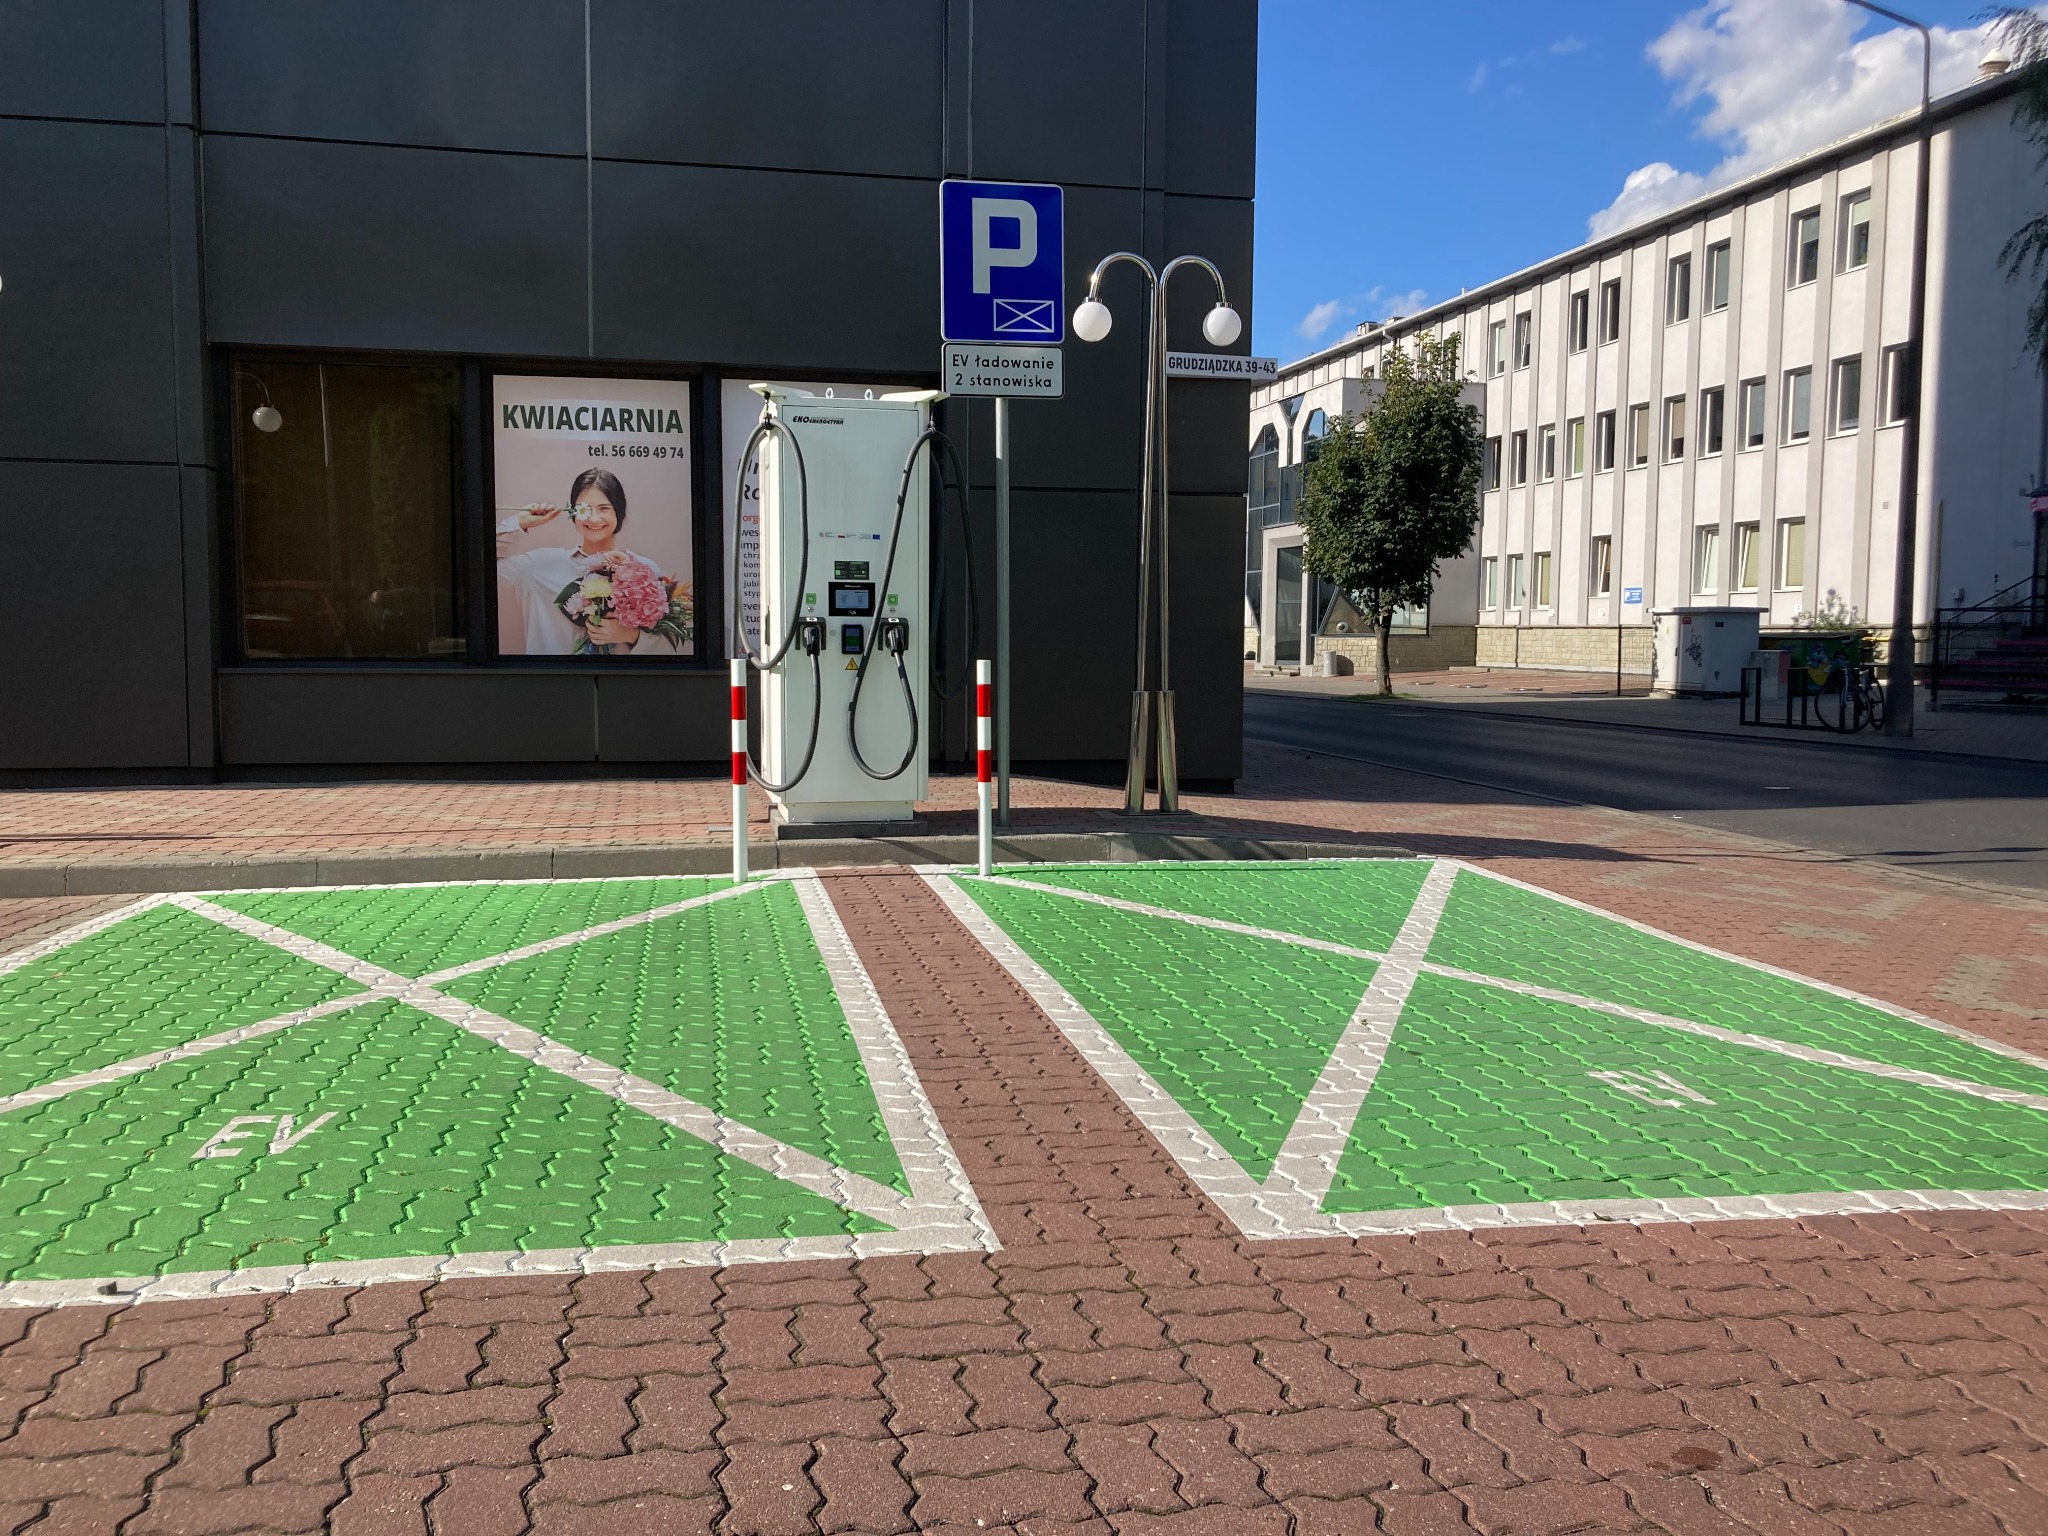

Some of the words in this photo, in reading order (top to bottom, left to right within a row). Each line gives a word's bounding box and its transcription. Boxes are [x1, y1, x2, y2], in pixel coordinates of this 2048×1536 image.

[972, 197, 1037, 294] P
[953, 355, 968, 367] EV
[975, 356, 1054, 369] ładowanie
[1168, 356, 1242, 374] GRUDZIĄDZKA
[1245, 362, 1276, 374] 39-43
[955, 373, 963, 386] 2
[970, 374, 1052, 388] stanowiska
[503, 404, 683, 433] KWIACIARNIA
[588, 444, 608, 457] tel.
[612, 445, 626, 458] 56
[629, 446, 649, 458] 669
[653, 447, 667, 458] 49
[670, 446, 684, 459] 74
[743, 515, 760, 524] org
[191, 1112, 339, 1158] EV
